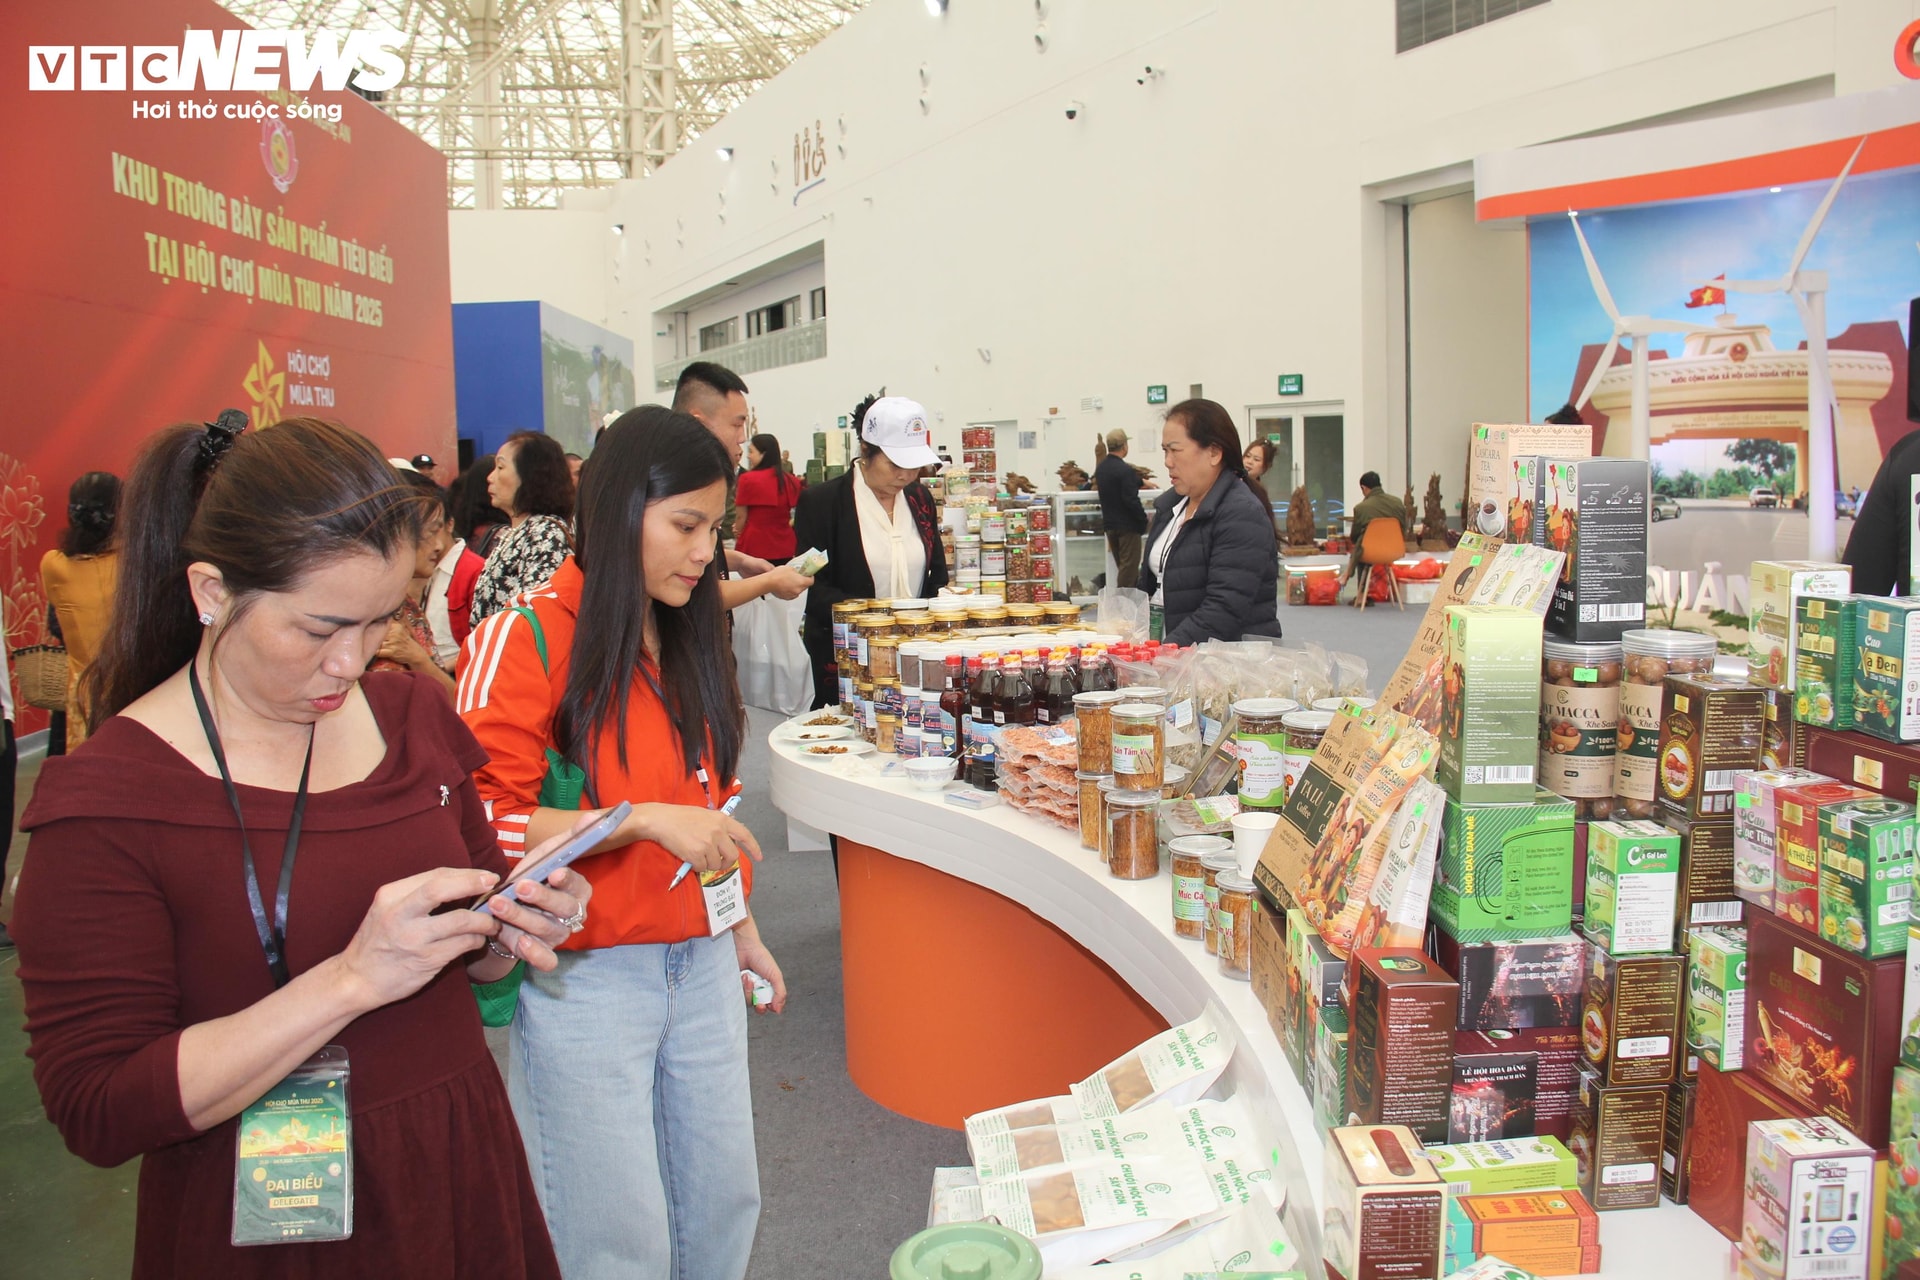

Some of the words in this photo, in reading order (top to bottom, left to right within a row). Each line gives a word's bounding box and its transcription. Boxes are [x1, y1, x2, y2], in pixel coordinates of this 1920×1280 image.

[112, 151, 159, 206] KHU
[162, 171, 228, 230] TRƯNG
[230, 195, 262, 241] BÀY
[266, 205, 298, 254] SẢN
[300, 220, 339, 267] PHẨM
[340, 238, 367, 275] TIÊU
[368, 243, 394, 284] BIỂU
[144, 231, 179, 285] TẠI
[183, 240, 217, 294] HỘI
[220, 255, 254, 304] CHỢ
[257, 263, 293, 306] MÙA
[294, 276, 322, 313] THU
[323, 281, 354, 320] NĂM
[355, 294, 383, 327] 2025
[287, 348, 307, 378] HỘI
[307, 354, 331, 381] CHỢ
[289, 381, 314, 406] MÙA
[314, 386, 335, 408] THU
[1865, 635, 1881, 648] Cao
[1876, 656, 1897, 673] Đen
[1556, 705, 1600, 719] MACCA
[1296, 801, 1311, 820] Coffee
[1748, 812, 1766, 828] Cao
[1756, 828, 1773, 847] Tiên
[1472, 1065, 1488, 1076] HỘI
[1490, 1065, 1505, 1075] HOA
[265, 1177, 289, 1195] ĐẠI
[292, 1172, 323, 1190] BIỂU
[273, 1196, 315, 1207] DELEGATE
